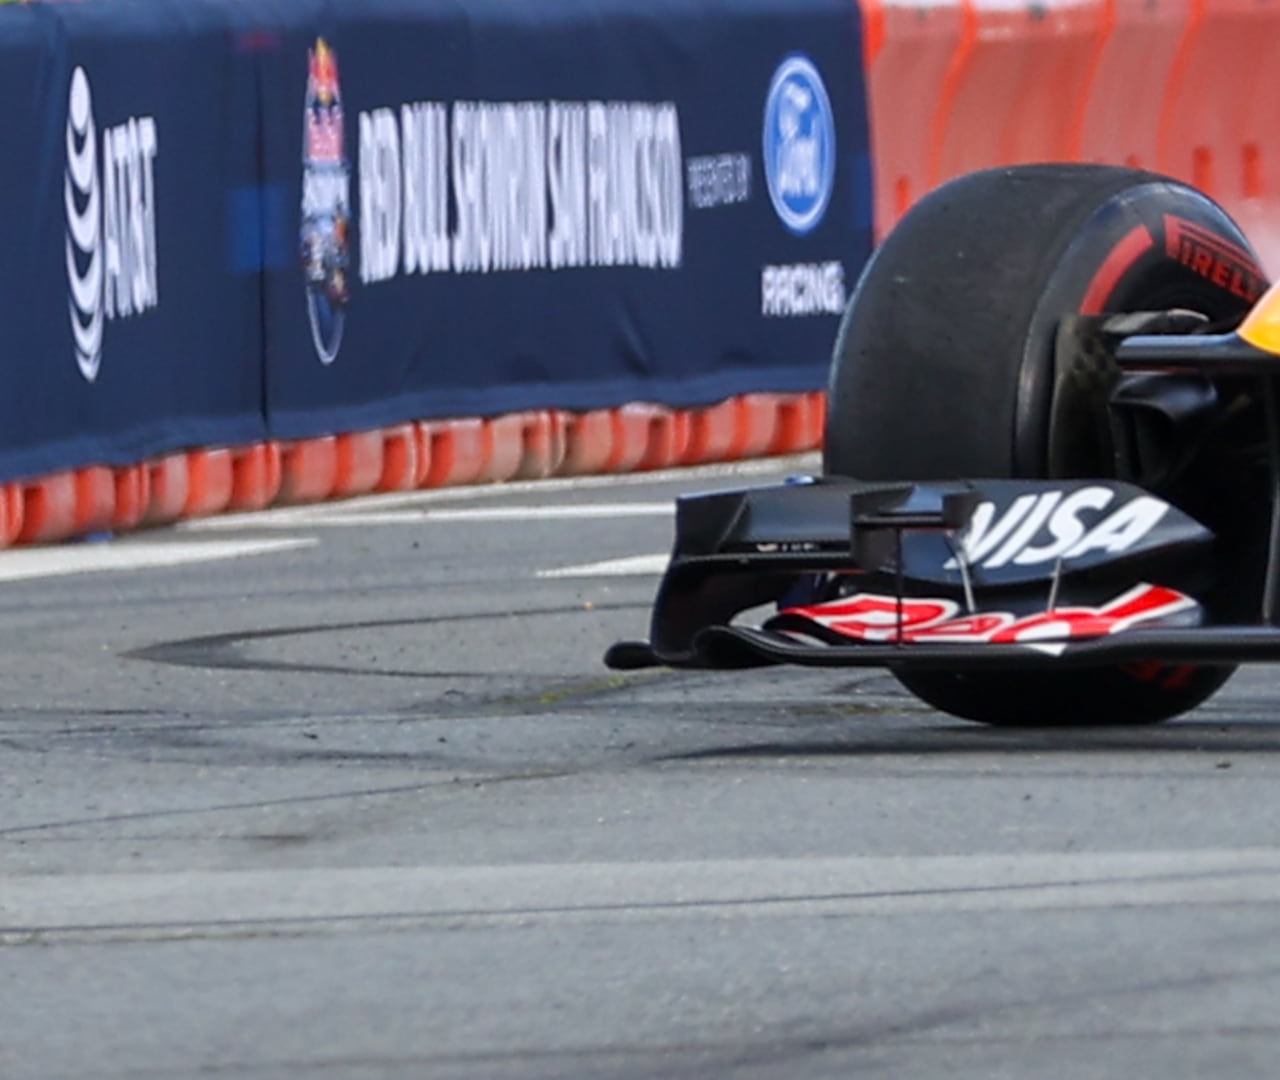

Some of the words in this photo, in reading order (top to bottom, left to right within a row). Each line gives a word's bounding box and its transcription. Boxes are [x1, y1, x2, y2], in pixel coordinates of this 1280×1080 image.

[359, 106, 400, 284] RED
[401, 101, 449, 274] BULL
[761, 261, 845, 316] RACING
[944, 486, 1170, 568] VISA
